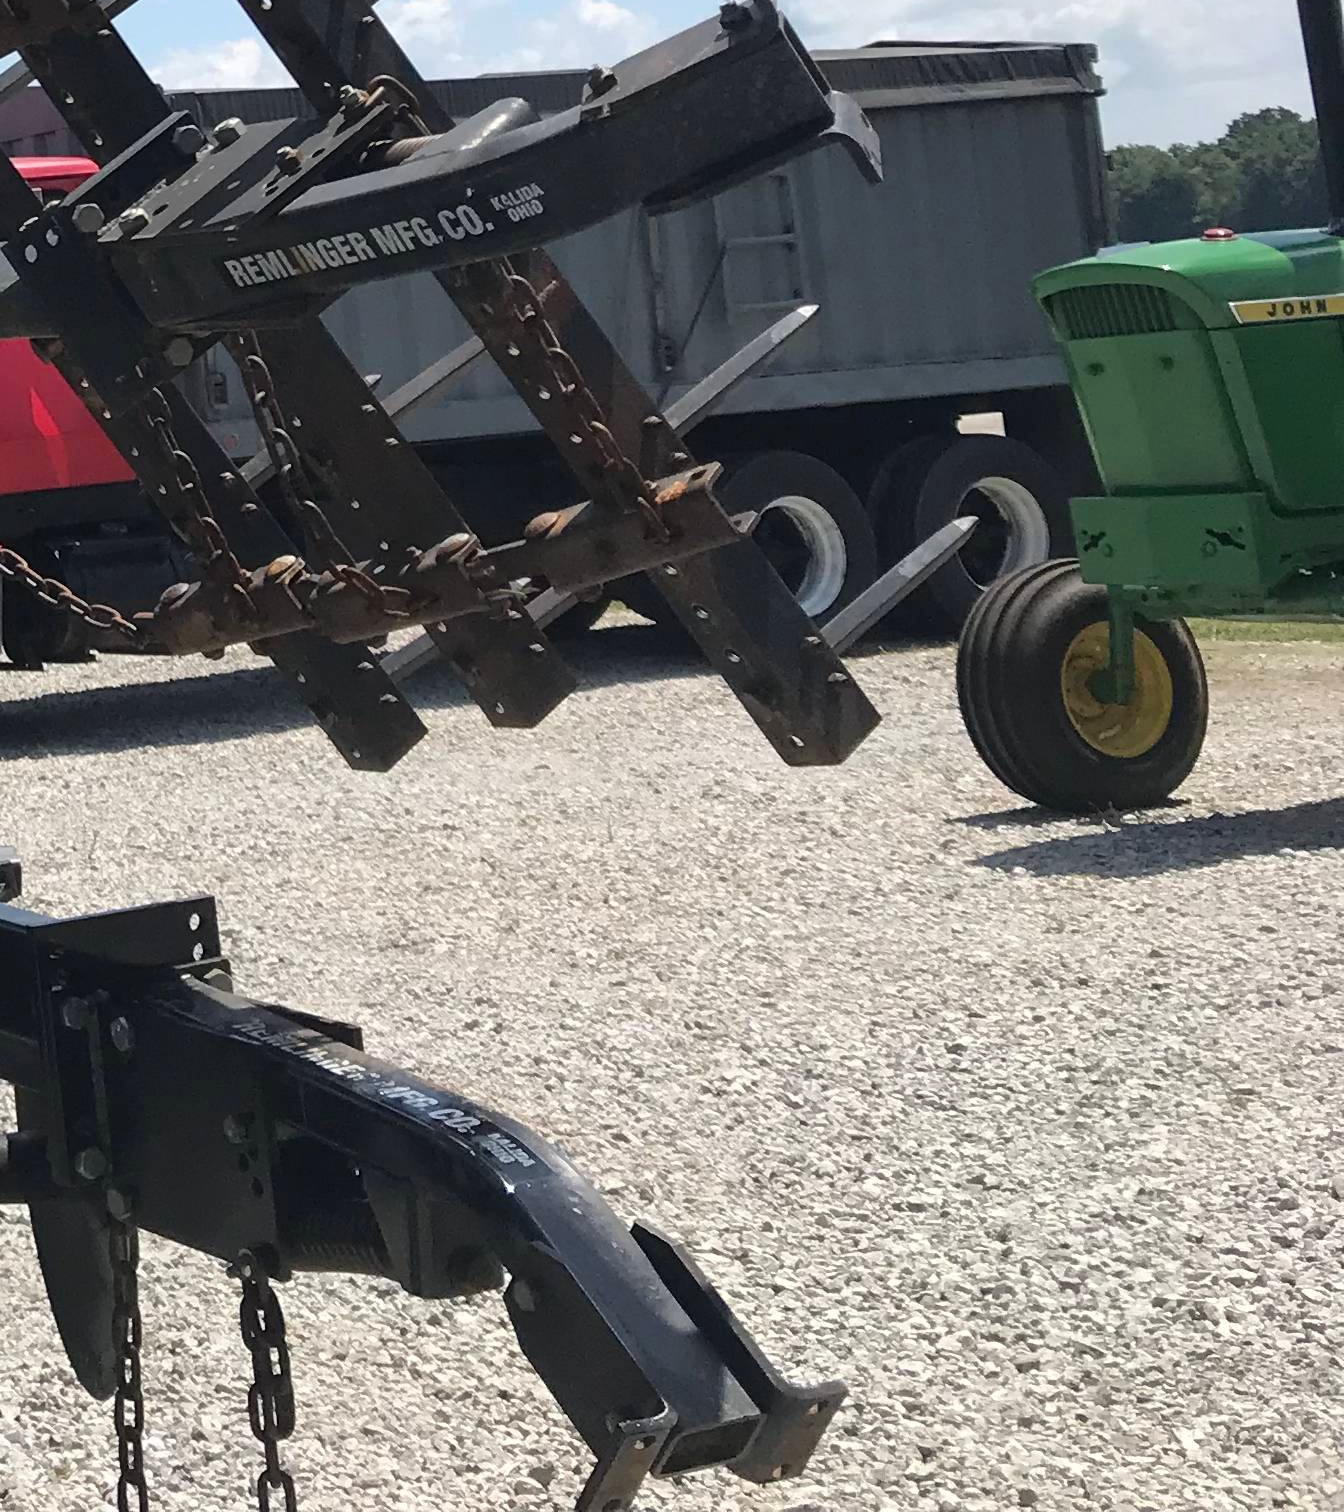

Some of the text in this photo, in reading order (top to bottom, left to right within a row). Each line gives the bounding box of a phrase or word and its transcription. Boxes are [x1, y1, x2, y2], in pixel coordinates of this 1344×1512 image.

[490, 183, 545, 212] KALIDA
[507, 199, 544, 223] OHIO
[224, 231, 377, 287] REMLINGER
[1266, 299, 1328, 318] JOHN
